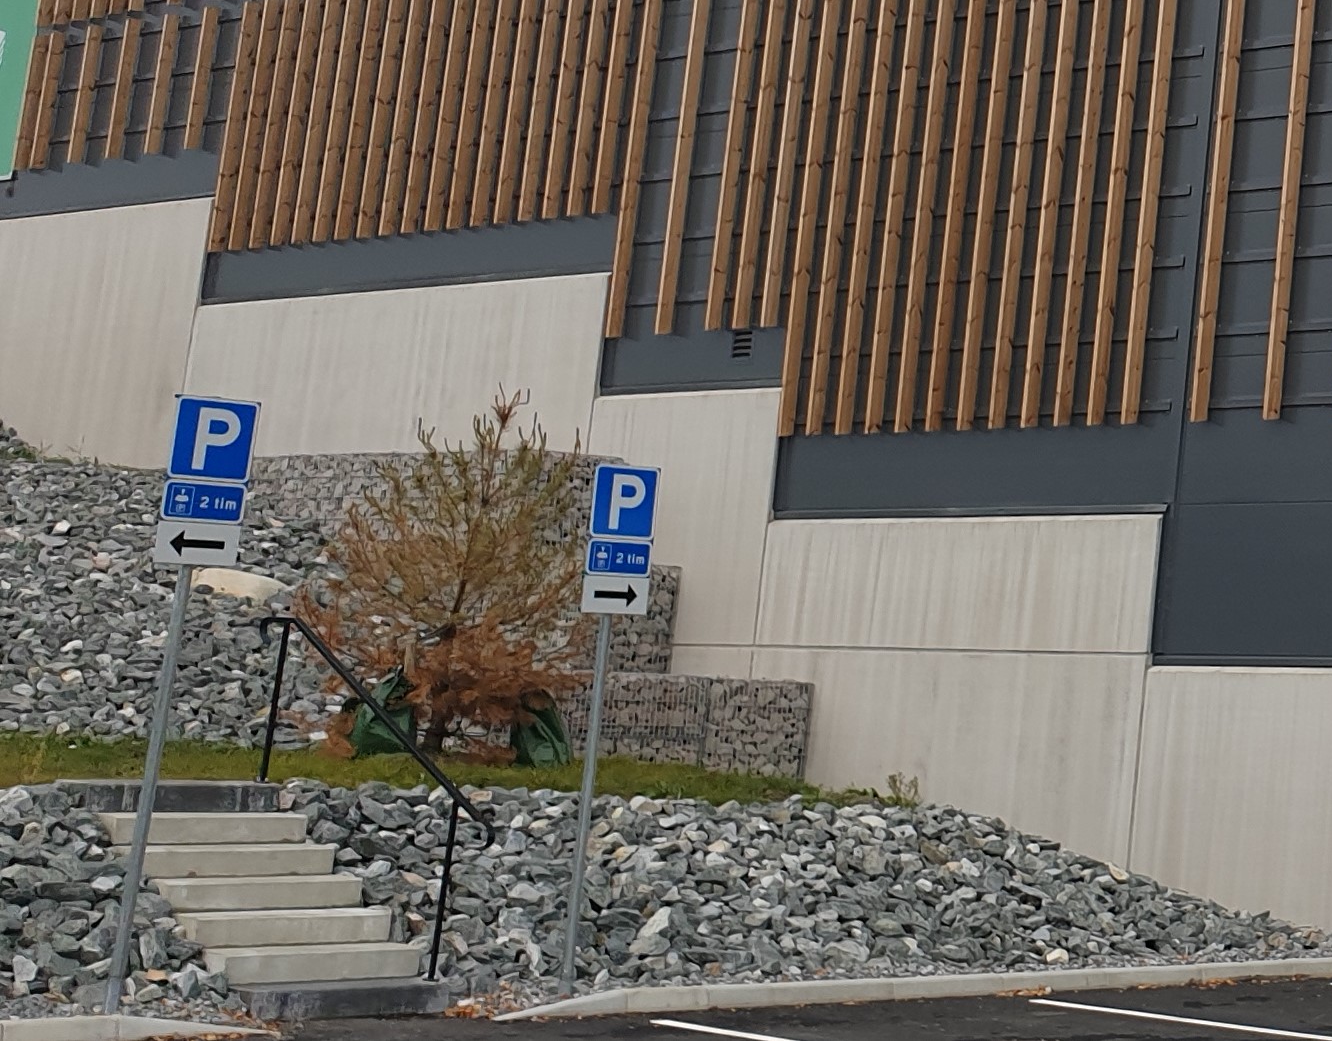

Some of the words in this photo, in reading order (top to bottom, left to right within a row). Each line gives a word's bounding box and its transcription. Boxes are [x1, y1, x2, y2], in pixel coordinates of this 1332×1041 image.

[191, 407, 242, 471] P
[199, 495, 210, 509] 2
[214, 497, 237, 511] tim
[607, 474, 645, 530] P
[615, 552, 624, 564] 2
